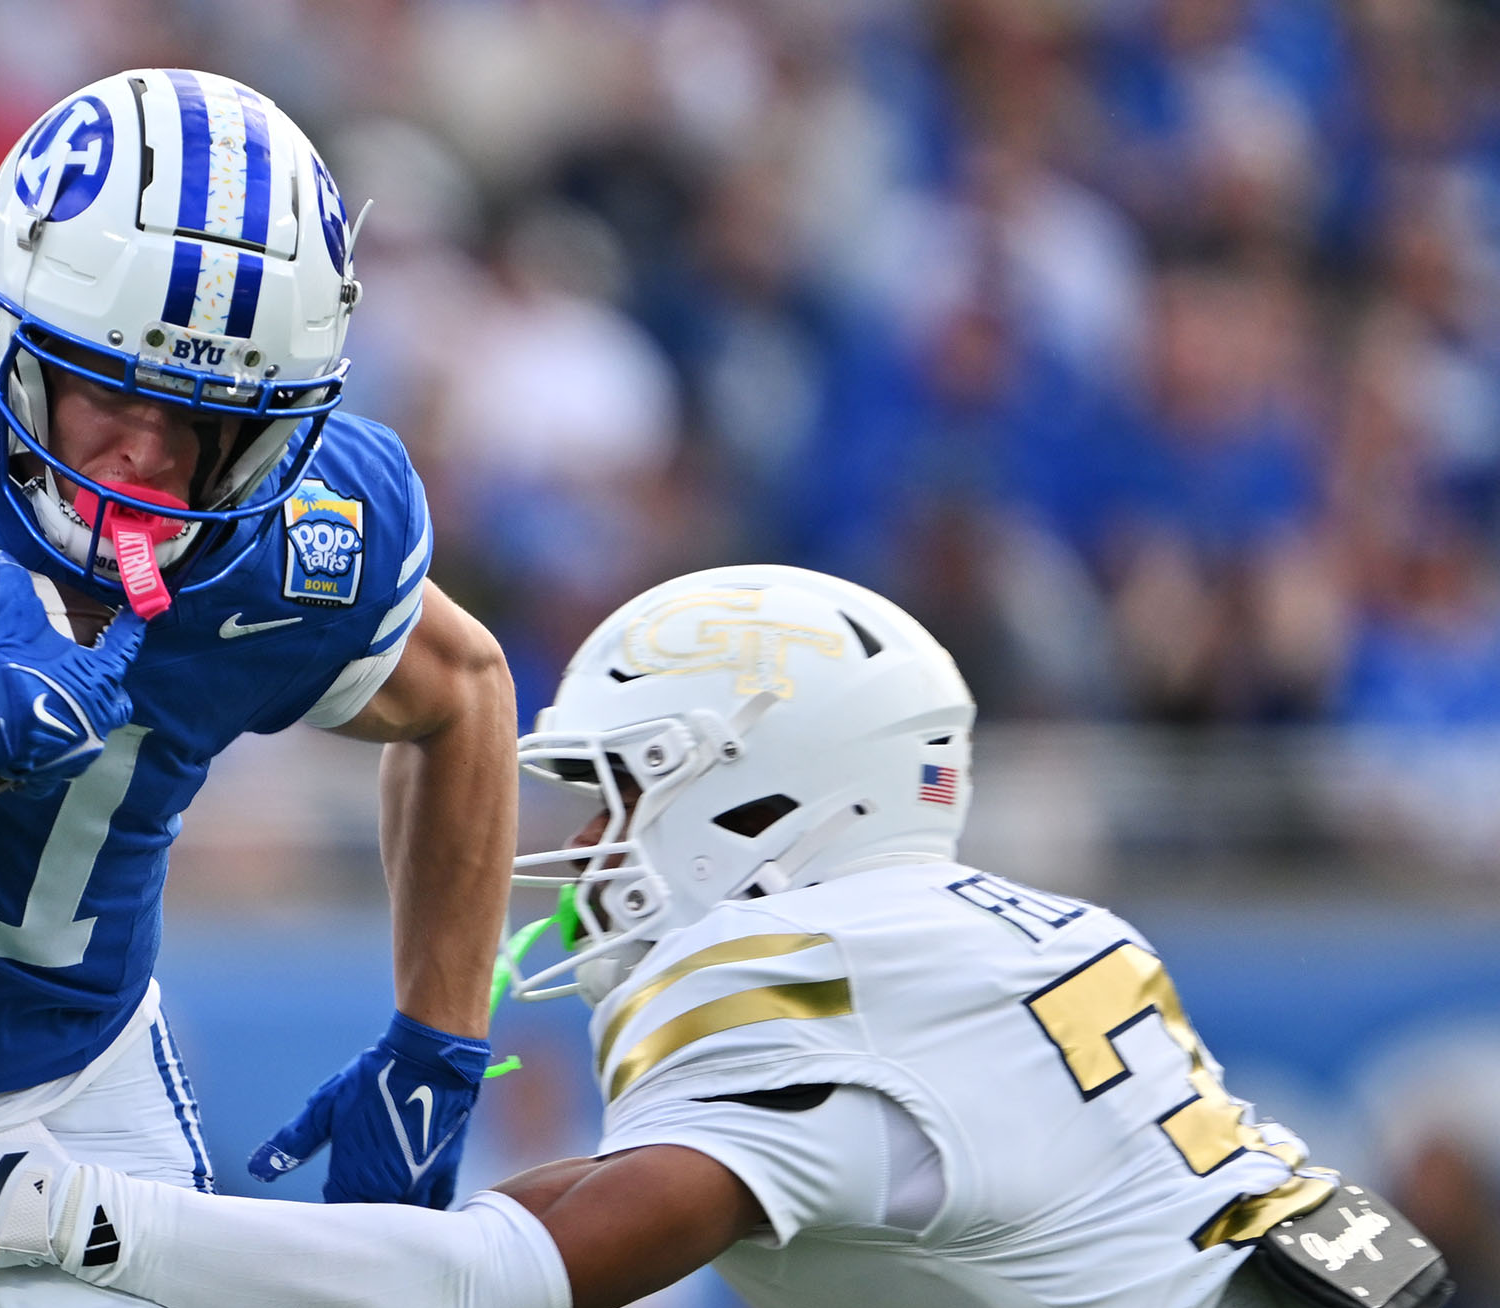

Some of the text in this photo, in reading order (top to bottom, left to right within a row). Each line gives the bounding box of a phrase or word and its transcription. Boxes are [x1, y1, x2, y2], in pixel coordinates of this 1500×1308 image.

[172, 337, 226, 366] BYU
[117, 530, 157, 595] NXTRND
[302, 551, 349, 571] tarts
[304, 580, 338, 593] BOWL
[624, 590, 844, 699] GT
